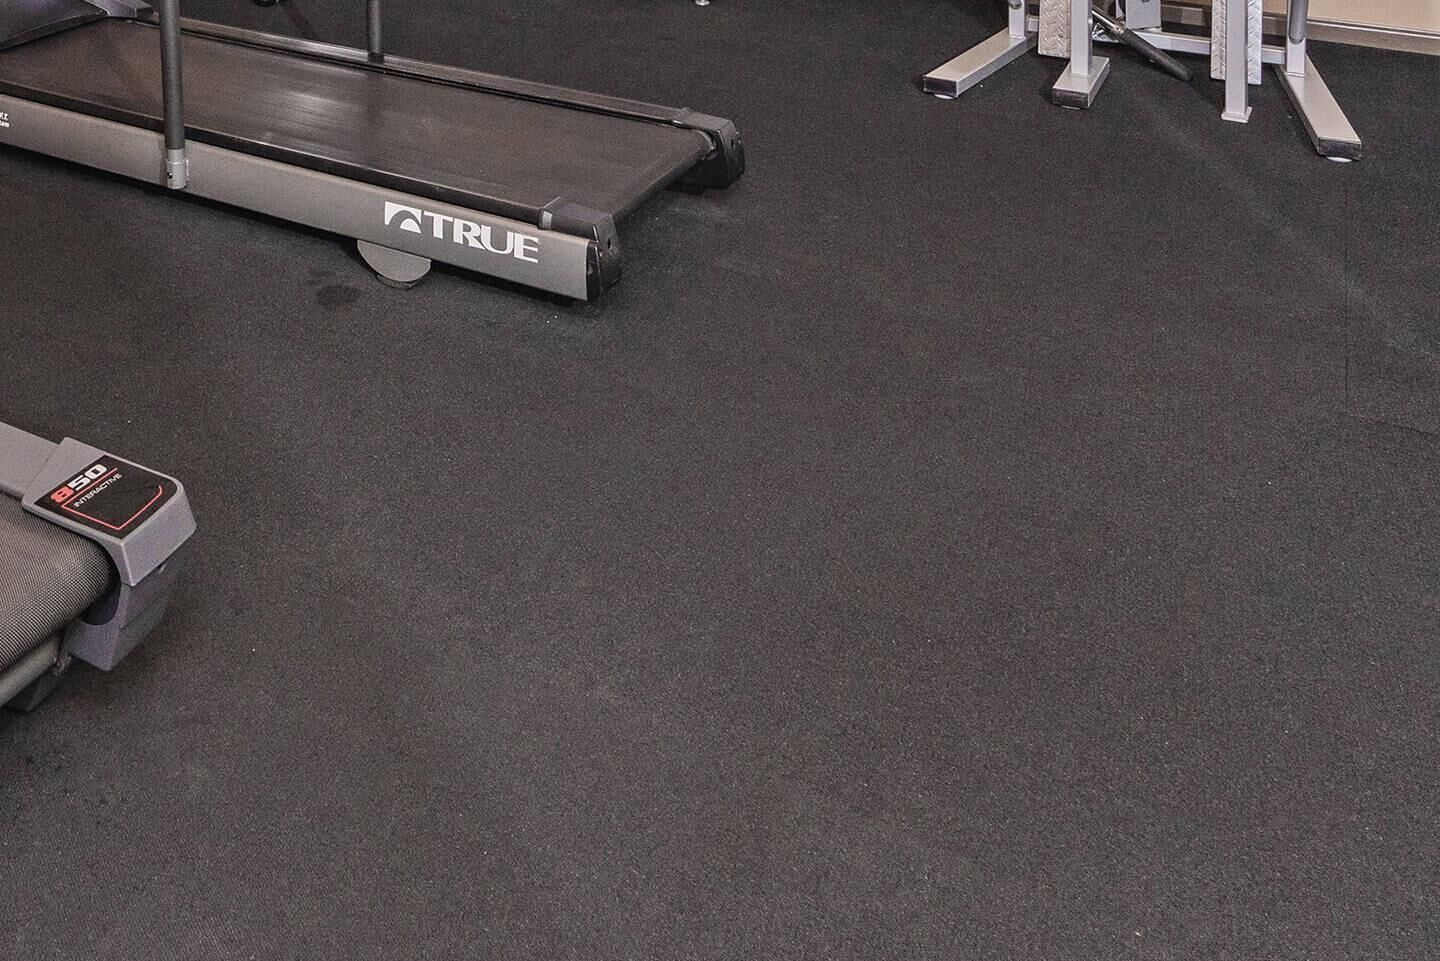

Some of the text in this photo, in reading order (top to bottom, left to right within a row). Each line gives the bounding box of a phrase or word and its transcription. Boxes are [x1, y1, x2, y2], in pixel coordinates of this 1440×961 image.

[423, 210, 539, 264] TRUE
[50, 463, 108, 504] 850
[73, 472, 123, 508] INTERACTIVE
